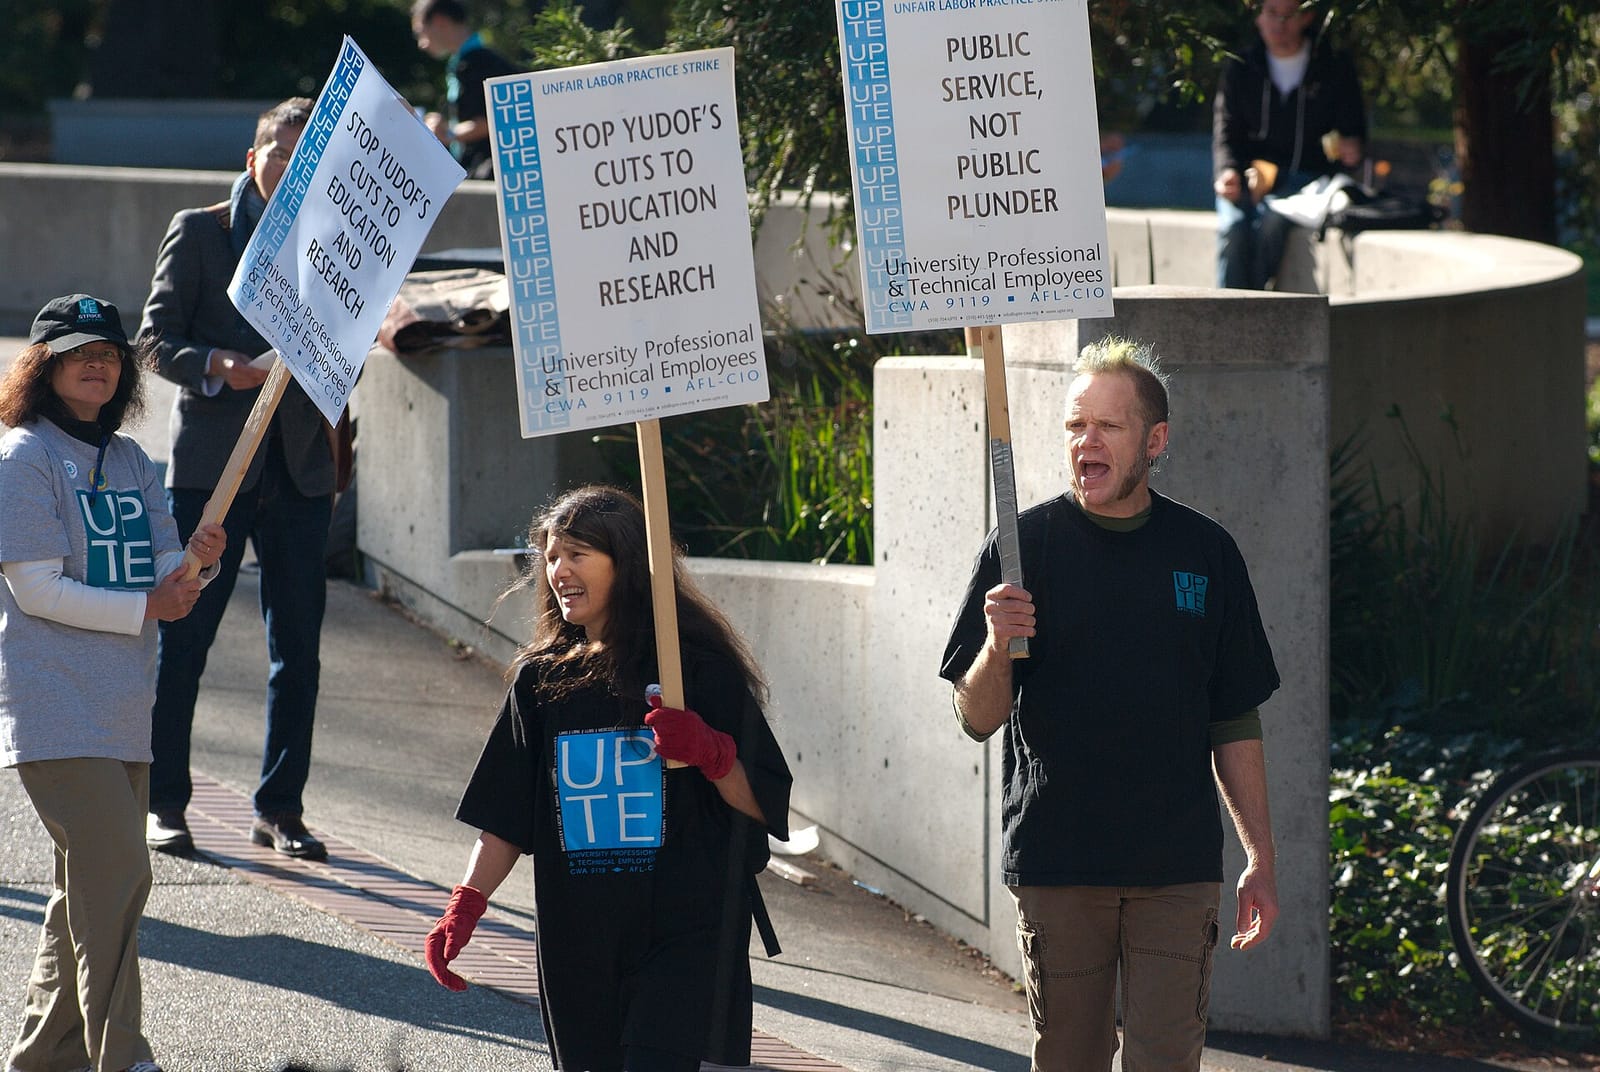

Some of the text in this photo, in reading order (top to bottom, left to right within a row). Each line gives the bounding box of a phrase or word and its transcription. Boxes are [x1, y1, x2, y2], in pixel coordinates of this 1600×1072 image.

[845, 1, 881, 20] UP
[894, 2, 936, 14] UNFAIR
[939, 0, 976, 10] LABOR
[847, 20, 883, 39] TE
[345, 44, 363, 70] UP
[848, 43, 885, 62] UP
[946, 31, 1031, 62] PUBLIC
[340, 59, 358, 86] TE
[542, 59, 720, 95] UNFAIR LABOR PRACTICE STRIKE
[851, 62, 887, 81] TE
[330, 76, 350, 102] UP
[493, 82, 530, 105] UP
[852, 83, 888, 103] UP
[941, 71, 1042, 102] SERVICE,
[325, 91, 342, 121] TE
[496, 103, 532, 124] TE
[855, 102, 891, 122] TE
[315, 107, 334, 133] UP
[555, 103, 722, 153] STOP YUDOF'S
[969, 112, 1021, 139] NOT
[310, 121, 328, 152] TE
[498, 127, 535, 148] UP
[856, 126, 892, 145] UP
[300, 139, 319, 165] UP
[502, 147, 537, 168] TE
[858, 144, 894, 163] TE
[957, 150, 1041, 179] PUBLIC
[296, 154, 314, 185] TE
[347, 111, 431, 220] STOP YUDOF'S
[594, 149, 693, 187] CUTS TO
[860, 166, 896, 185] UP
[286, 170, 306, 195] UP
[350, 160, 401, 228] CUTS TO
[503, 171, 540, 192] UP
[863, 184, 898, 203] TE
[282, 185, 299, 214] TE
[506, 190, 543, 211] TE
[579, 184, 717, 230] EDUCATION
[947, 188, 1059, 219] PLUNDER
[271, 202, 292, 228] UP
[326, 175, 397, 270] EDUCATION
[508, 215, 544, 237] UP
[864, 207, 900, 227] UP
[266, 217, 286, 247] TE
[512, 234, 547, 256] TE
[866, 226, 902, 245] TE
[333, 231, 362, 270] AND
[629, 231, 678, 263] AND
[885, 243, 1101, 275] University Professional
[306, 238, 365, 320] RESEARCH
[513, 258, 549, 279] UP
[517, 277, 552, 298] TE
[599, 264, 715, 307] RESEARCH
[888, 269, 1103, 297] & Technical Employees
[518, 302, 554, 324] UP
[889, 288, 1104, 313] CWA 9119 AFL-CIO
[257, 249, 303, 312] University
[303, 306, 356, 380] Professional
[248, 267, 260, 285] &
[258, 277, 302, 336] Technical
[301, 332, 347, 396] Employees
[522, 322, 558, 342] TE
[241, 282, 264, 311] CWA
[270, 315, 293, 343] 9119
[305, 362, 342, 408] AFL-CIO
[542, 324, 754, 374] University Professional
[545, 351, 757, 397] & Technical Employees
[545, 397, 587, 414] CWA
[604, 388, 650, 405] 9119
[686, 370, 760, 392] AFL-CIO
[81, 494, 143, 537] UP
[91, 540, 154, 583] TE
[1176, 573, 1206, 591] UP
[1178, 588, 1204, 611] TE
[562, 736, 658, 790] UP
[565, 792, 655, 843] TE
[568, 850, 608, 859] UNIVERSITY
